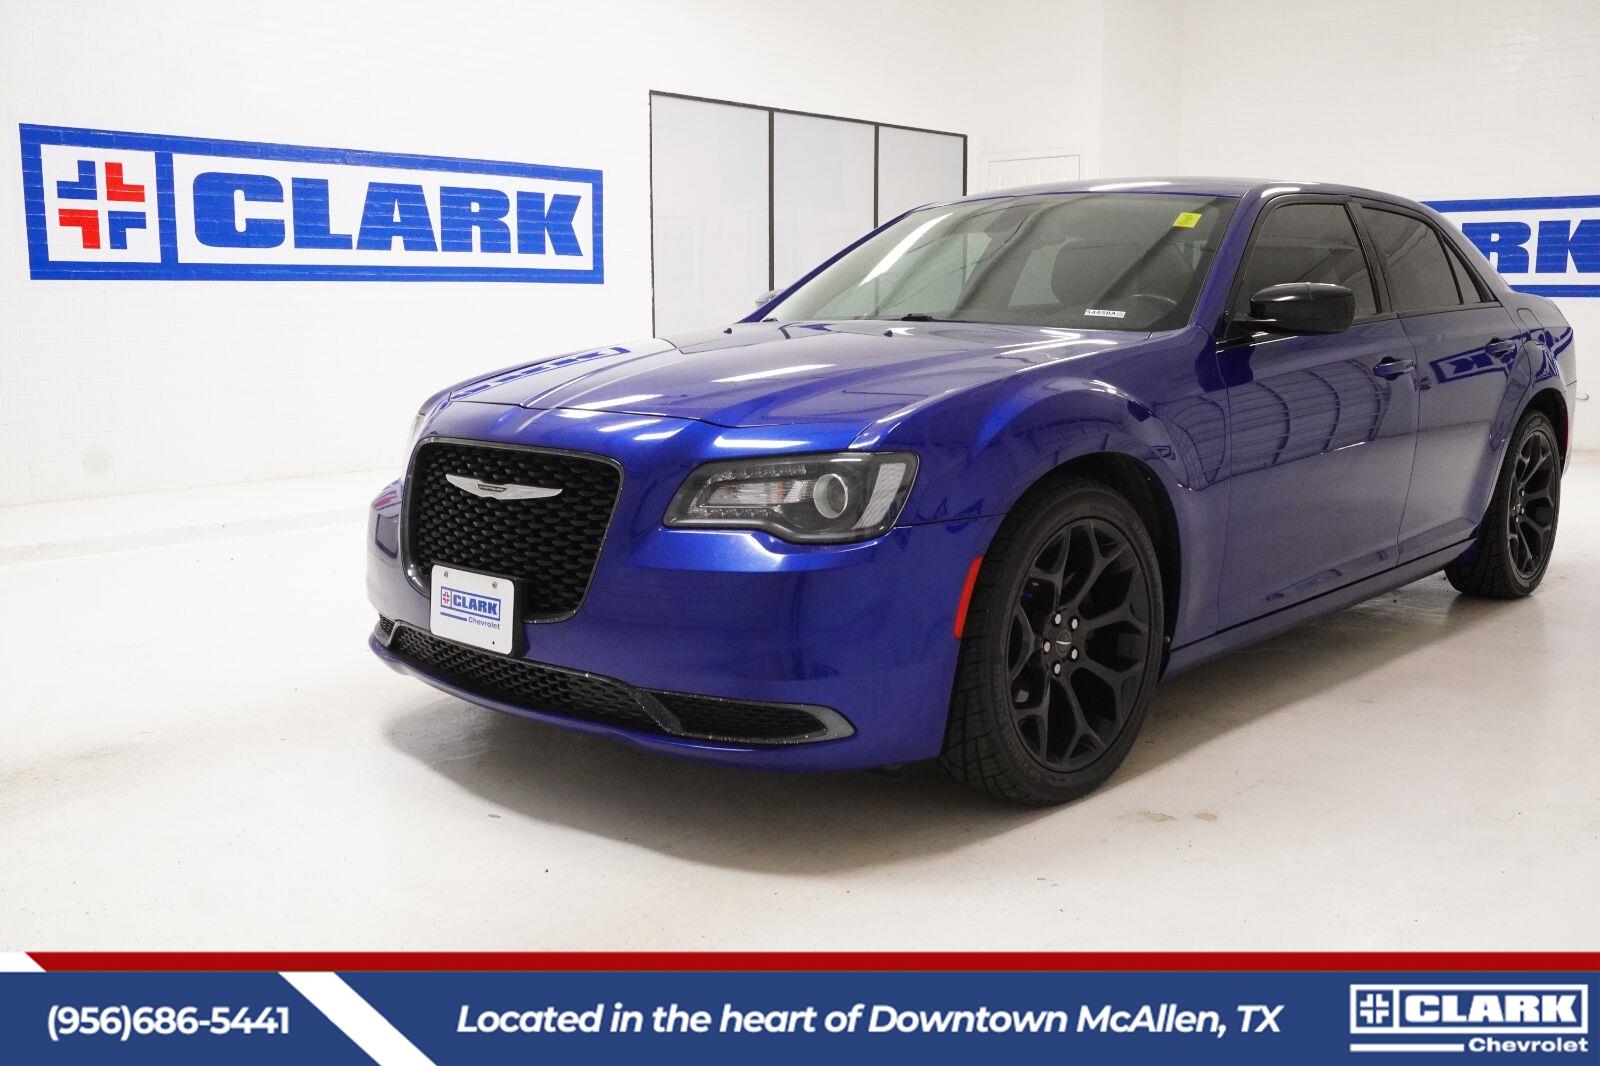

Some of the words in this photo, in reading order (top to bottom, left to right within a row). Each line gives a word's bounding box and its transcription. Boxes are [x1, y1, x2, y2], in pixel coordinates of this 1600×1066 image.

[193, 171, 584, 257] CLARK
[452, 595, 498, 616] CLARK
[468, 616, 501, 630] Chevrolet
